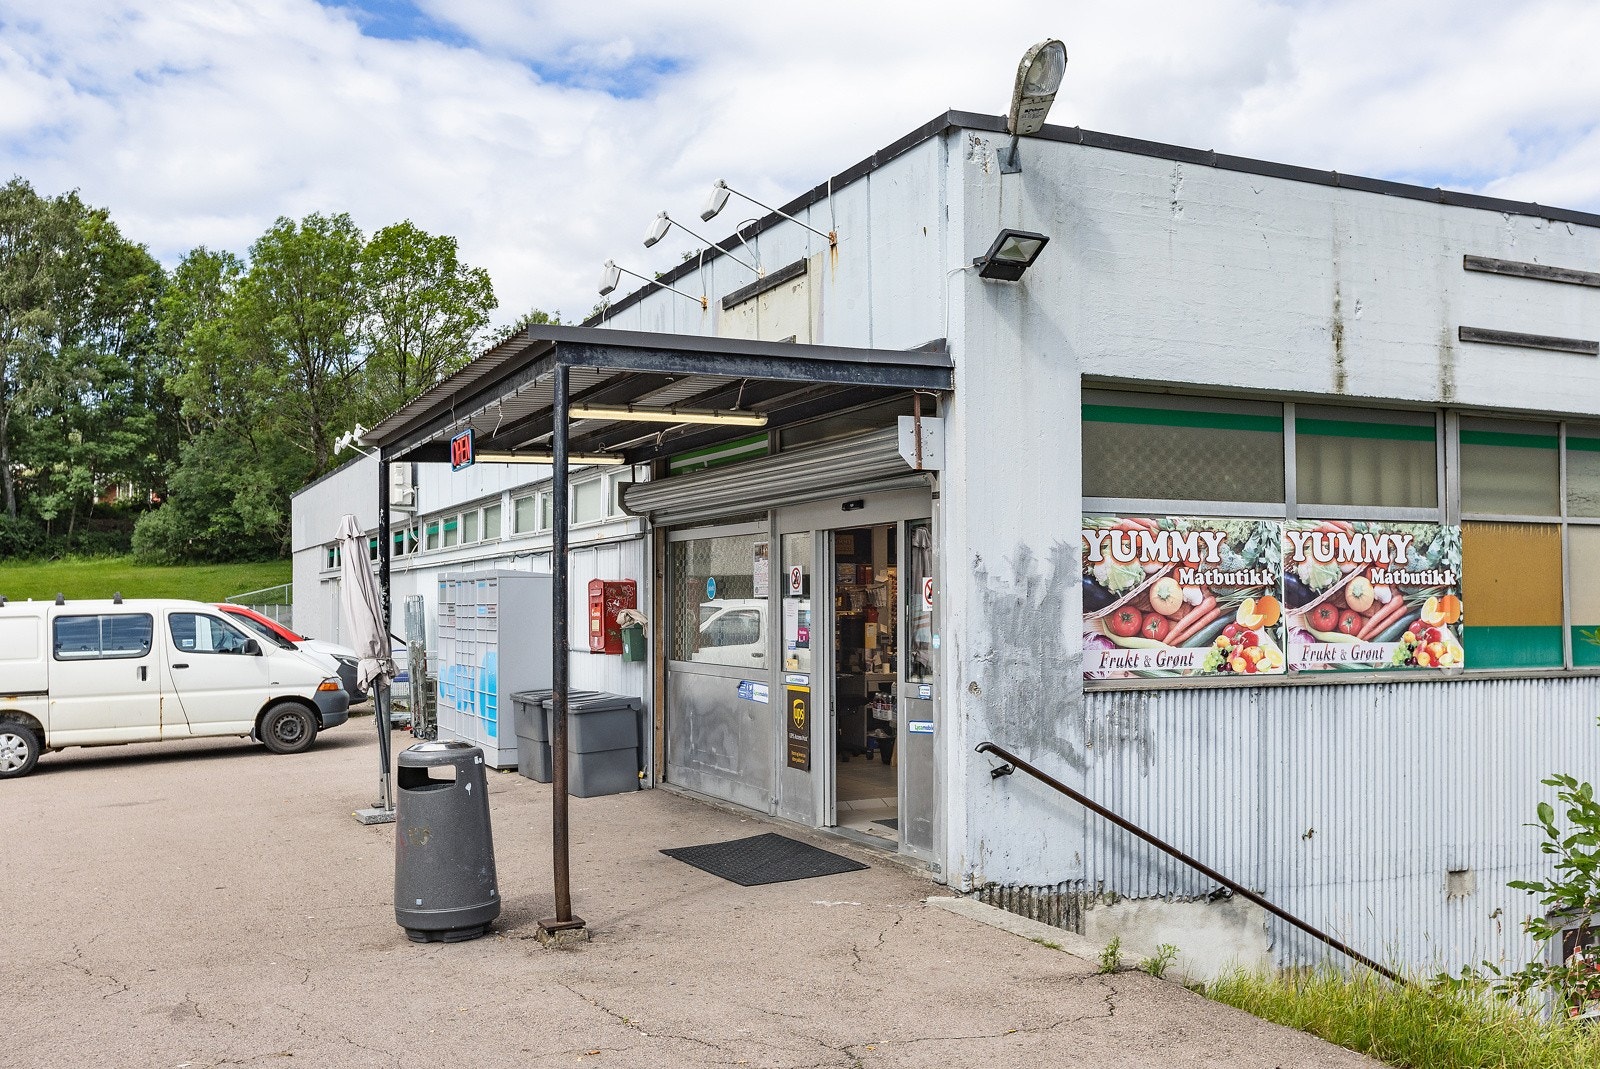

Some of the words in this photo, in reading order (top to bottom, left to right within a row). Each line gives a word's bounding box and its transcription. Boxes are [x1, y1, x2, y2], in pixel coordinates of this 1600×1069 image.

[452, 435, 470, 466] OPEN
[1082, 529, 1226, 563] YUMMY
[1287, 531, 1413, 564] YUMMY
[1179, 568, 1275, 586] Matbutikk
[1371, 568, 1457, 586] Matbutikk
[1100, 651, 1140, 669] Frukt
[1143, 656, 1152, 668] &
[1156, 650, 1195, 668] Grønt
[1301, 645, 1337, 661] Frukt
[1340, 650, 1348, 661] &
[1351, 646, 1385, 661] Grønt
